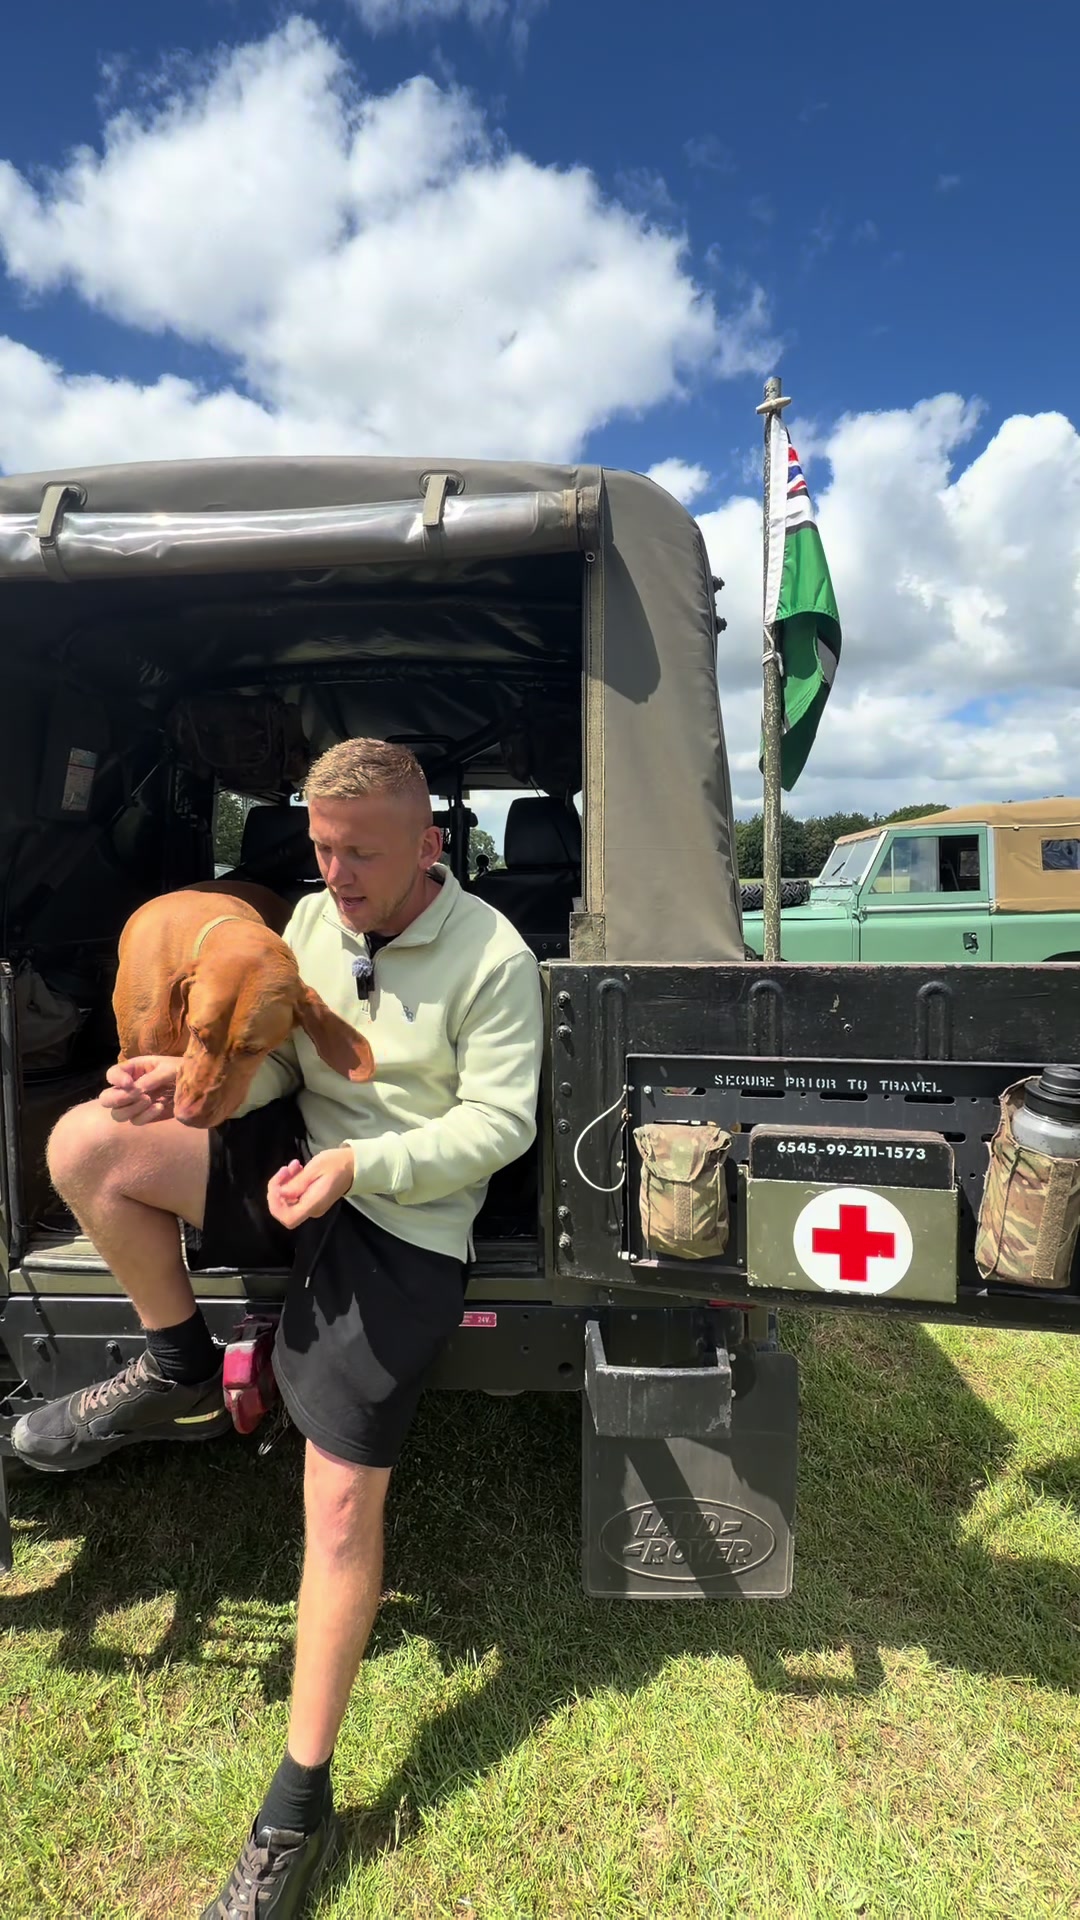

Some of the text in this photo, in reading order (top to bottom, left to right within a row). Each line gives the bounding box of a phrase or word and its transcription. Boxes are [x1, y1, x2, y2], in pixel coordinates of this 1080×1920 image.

[714, 1074, 942, 1093] SECURE PRIOR TO TRAVEL
[777, 1141, 926, 1160] 6545-99-211-1573
[634, 1510, 721, 1538] LAND
[640, 1538, 753, 1564] ROVER
